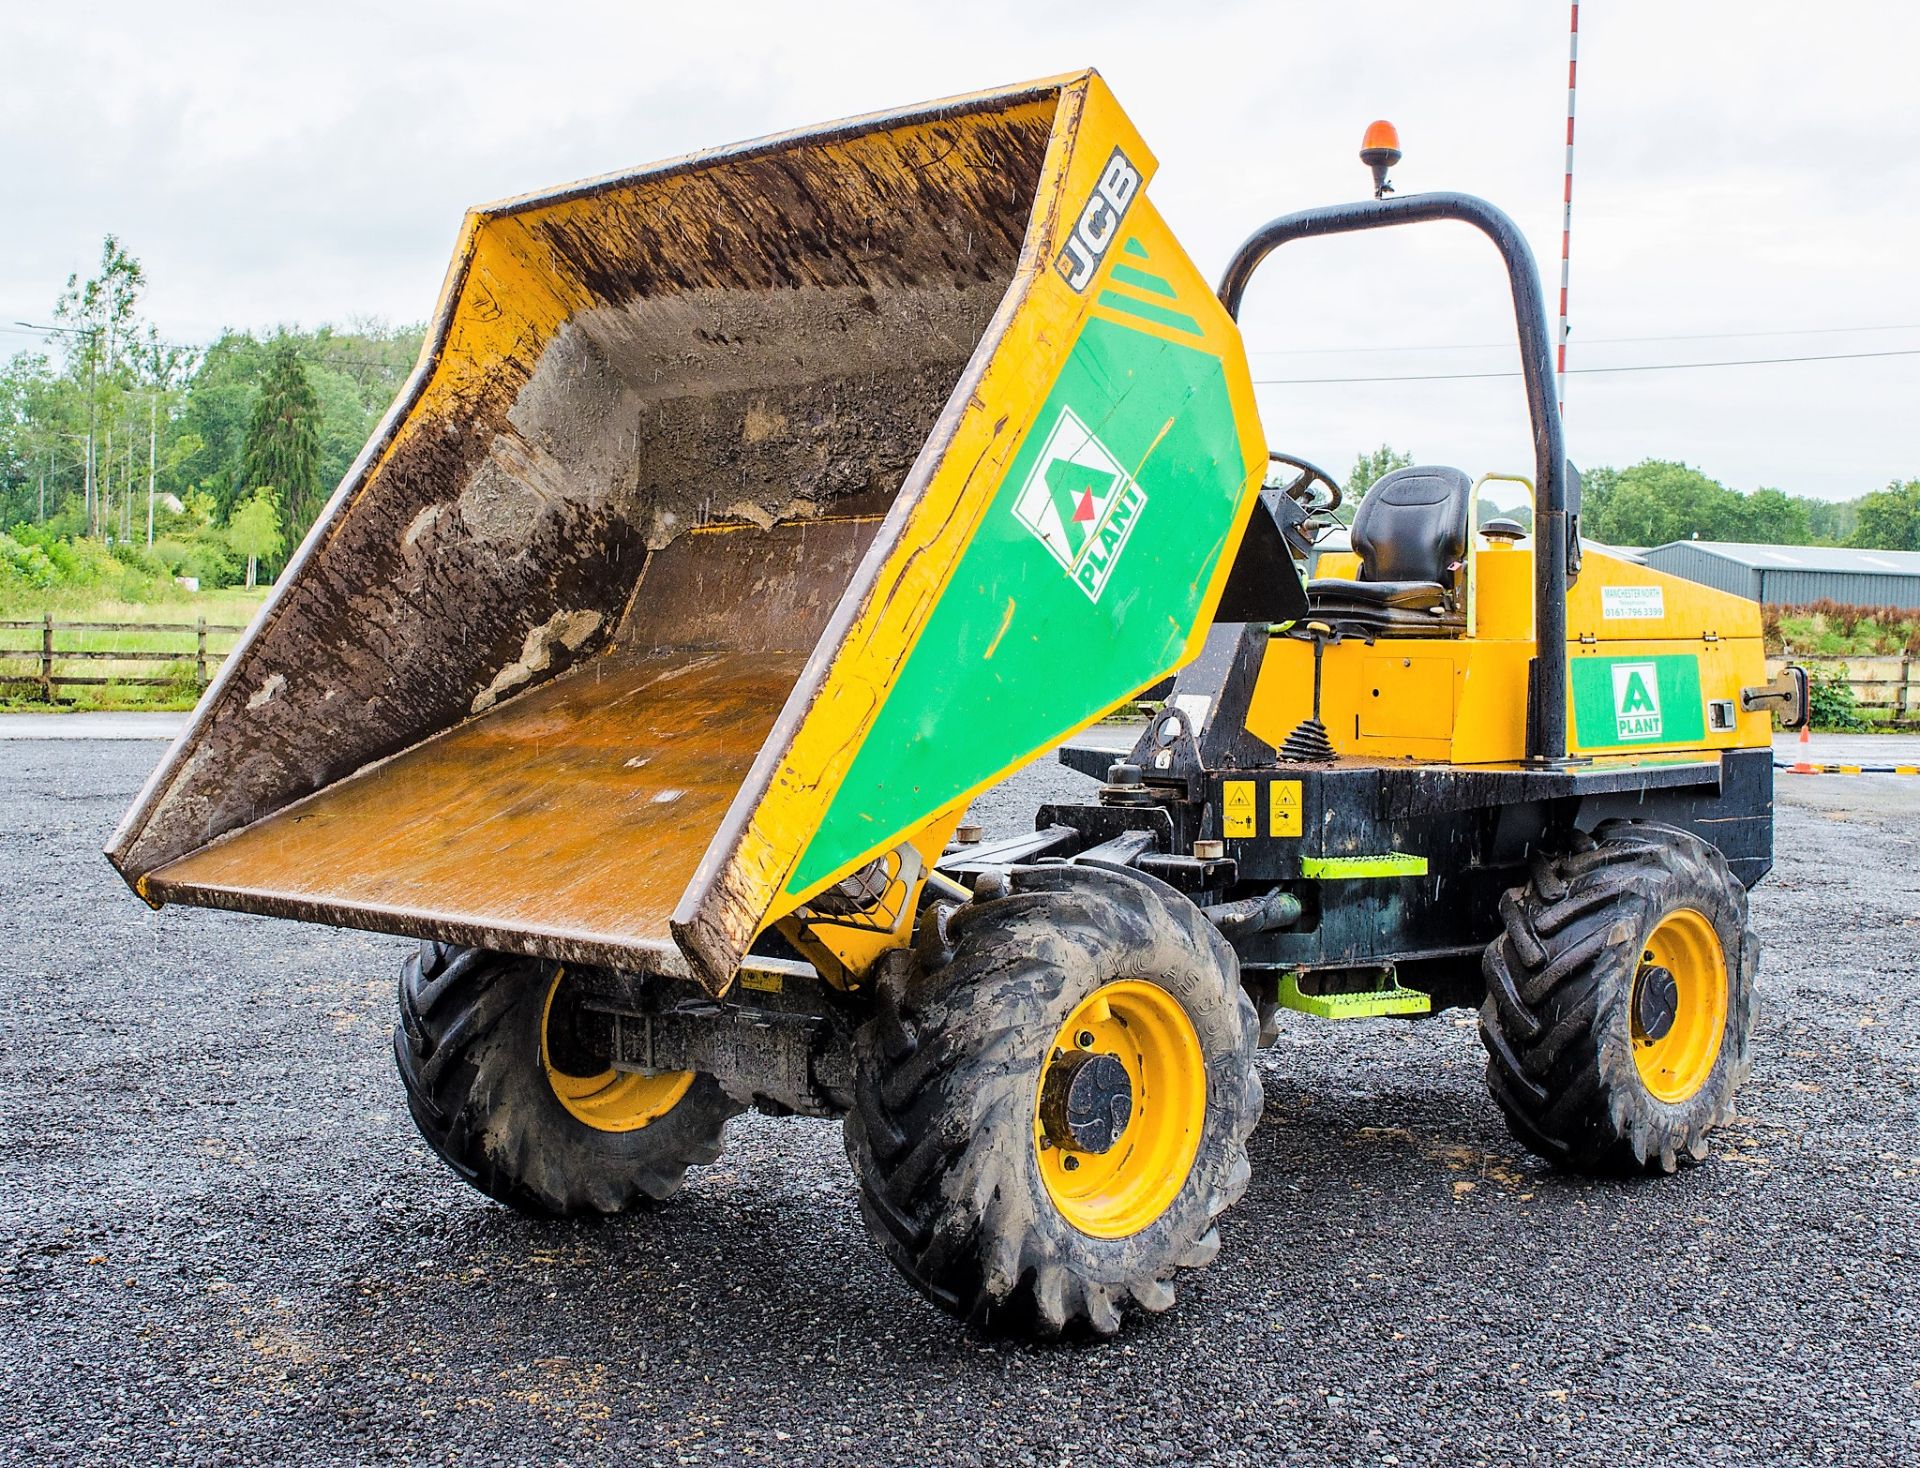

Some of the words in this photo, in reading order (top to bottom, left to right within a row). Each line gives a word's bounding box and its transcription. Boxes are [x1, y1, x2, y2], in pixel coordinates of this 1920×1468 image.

[1069, 154, 1138, 291] JCB
[1044, 457, 1118, 563] A
[1076, 479, 1139, 594] PLANT
[1619, 718, 1660, 734] PLANT
[1621, 671, 1656, 714] A
[1160, 965, 1200, 997] AS
